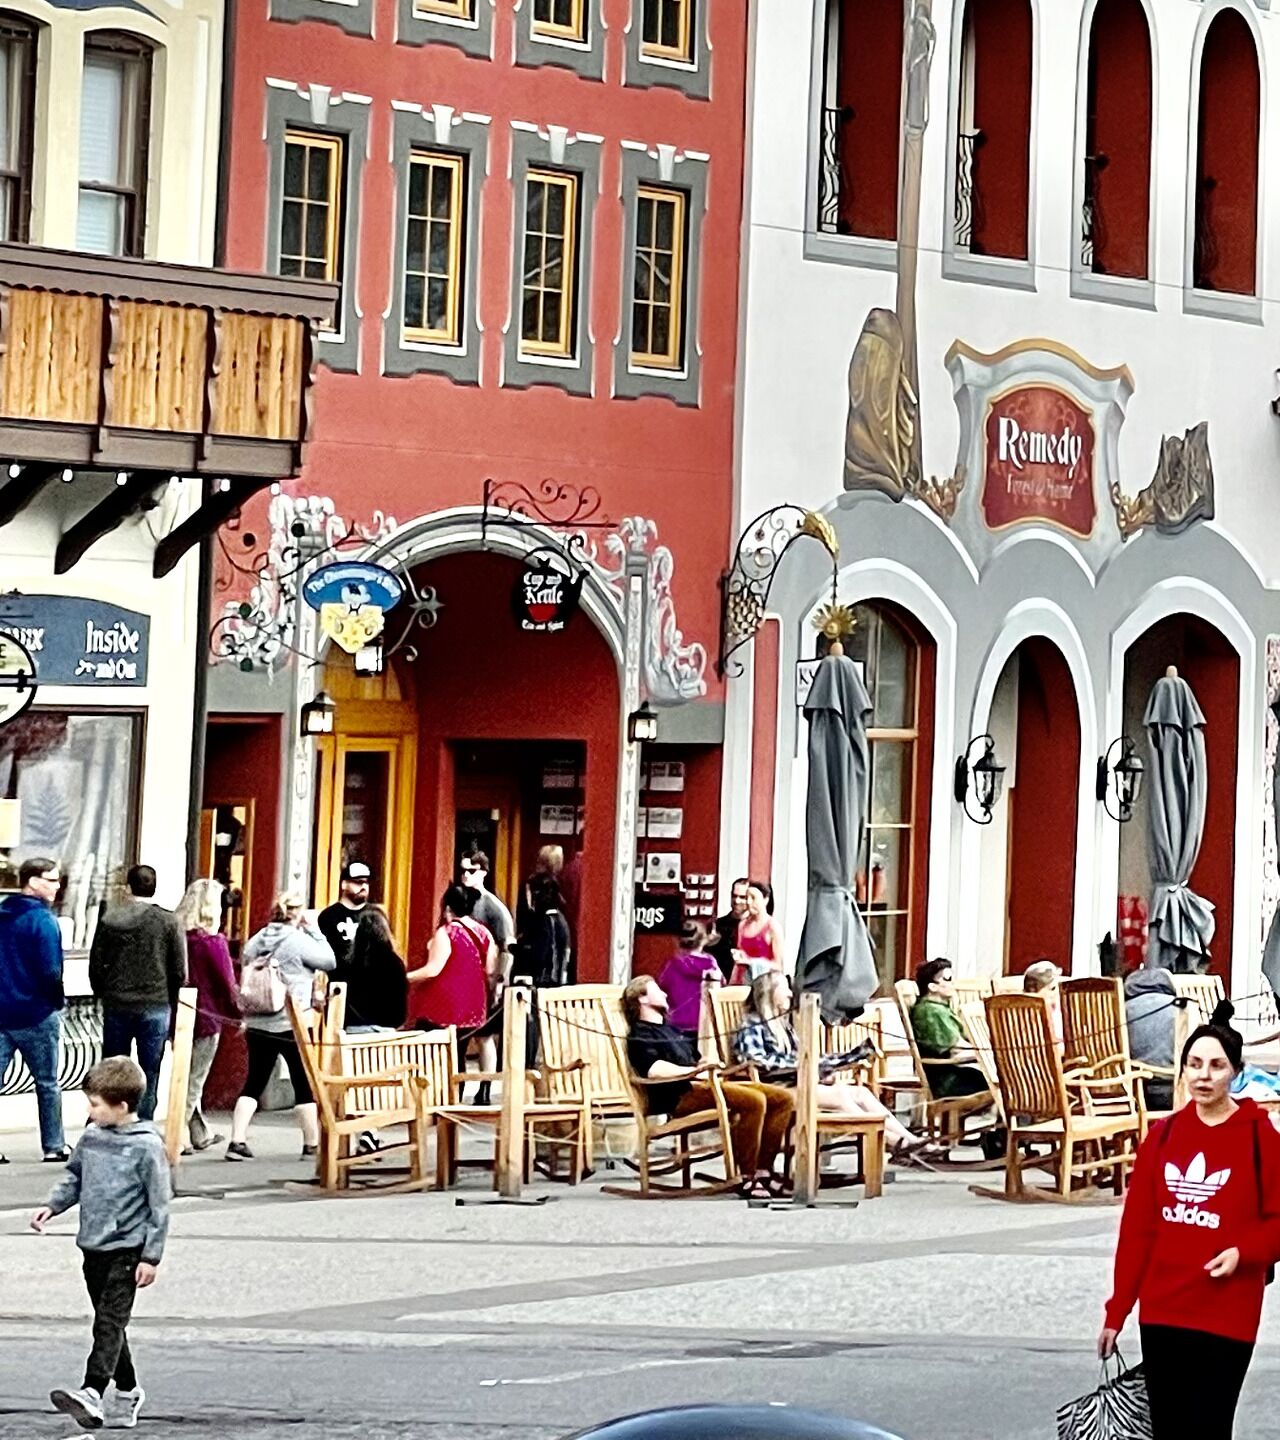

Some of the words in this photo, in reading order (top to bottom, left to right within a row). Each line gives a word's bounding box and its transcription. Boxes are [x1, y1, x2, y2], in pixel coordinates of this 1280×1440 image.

[999, 416, 1082, 479] Remedy
[86, 620, 139, 654] Inside
[1162, 1202, 1220, 1229] adidas
